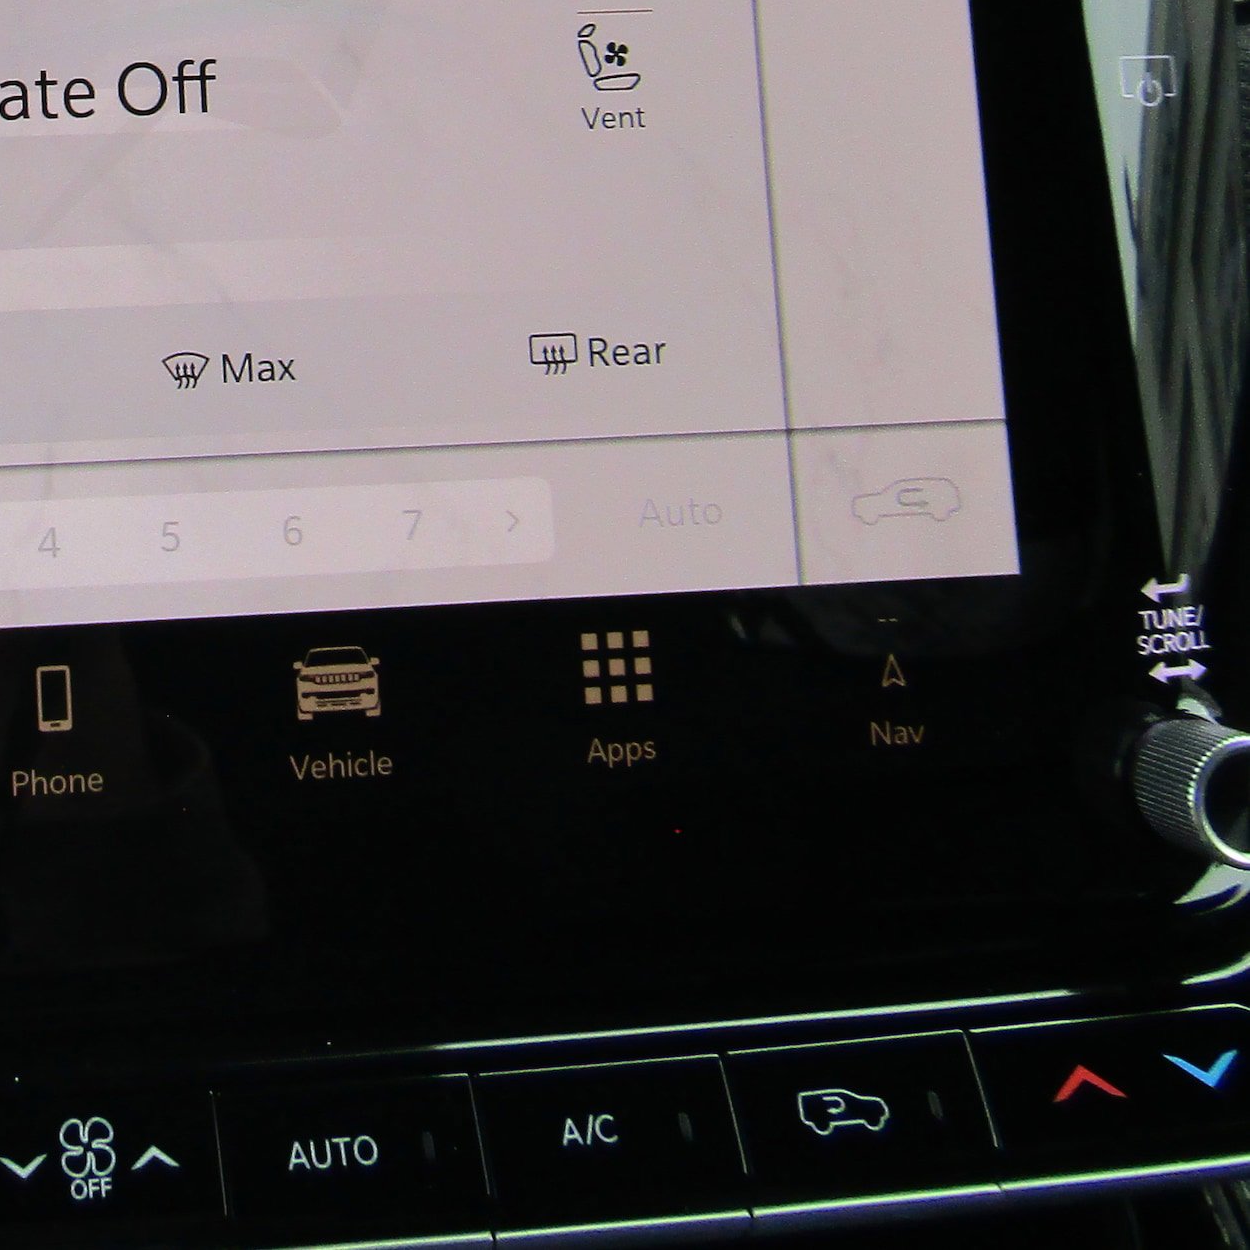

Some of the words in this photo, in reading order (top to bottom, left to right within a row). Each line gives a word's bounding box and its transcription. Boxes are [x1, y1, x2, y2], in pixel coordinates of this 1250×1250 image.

[117, 58, 217, 117] Off
[580, 107, 646, 130] Vent
[588, 337, 666, 367] Rear
[221, 352, 296, 384] Max
[639, 498, 723, 528] Auto
[37, 526, 61, 559] 4
[161, 520, 181, 553] 5
[283, 515, 304, 547] 6
[402, 508, 423, 541] 7
[1135, 629, 1212, 656] SCROLL
[870, 721, 924, 746] Nav
[289, 750, 393, 781] Vehicle
[587, 737, 657, 769] Apps
[11, 769, 104, 797] Phone
[562, 1113, 618, 1146] A/C
[288, 1134, 379, 1171] AUTO
[70, 1177, 113, 1201] OFF
